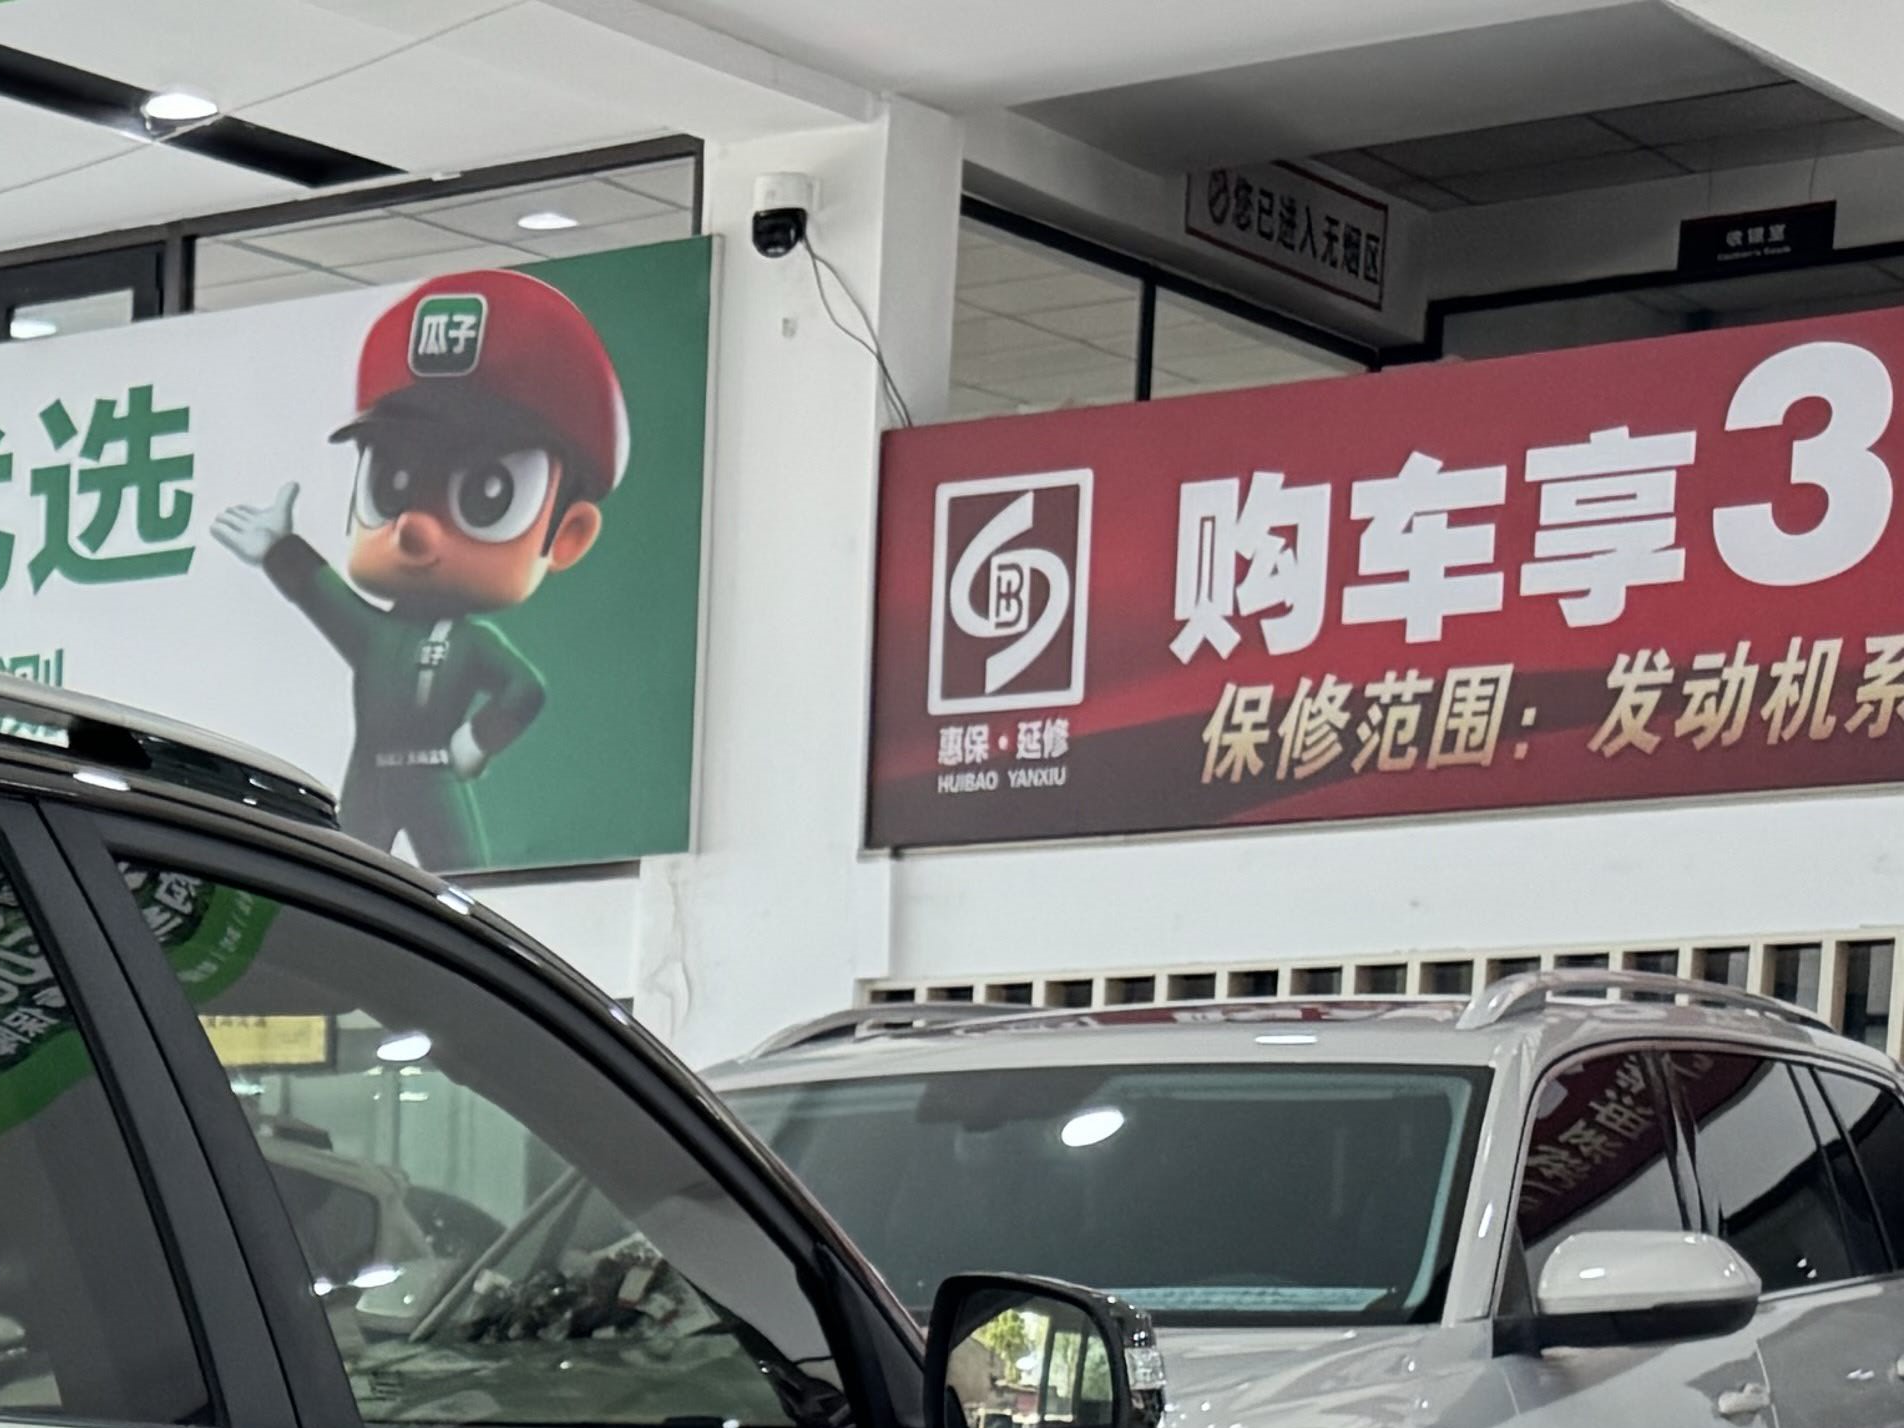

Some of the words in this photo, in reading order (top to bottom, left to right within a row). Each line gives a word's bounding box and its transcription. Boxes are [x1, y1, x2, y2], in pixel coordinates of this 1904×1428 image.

[418, 314, 477, 355] 瓜子
[937, 770, 999, 794] HUIBAO
[1007, 766, 1067, 788] YANXIU
